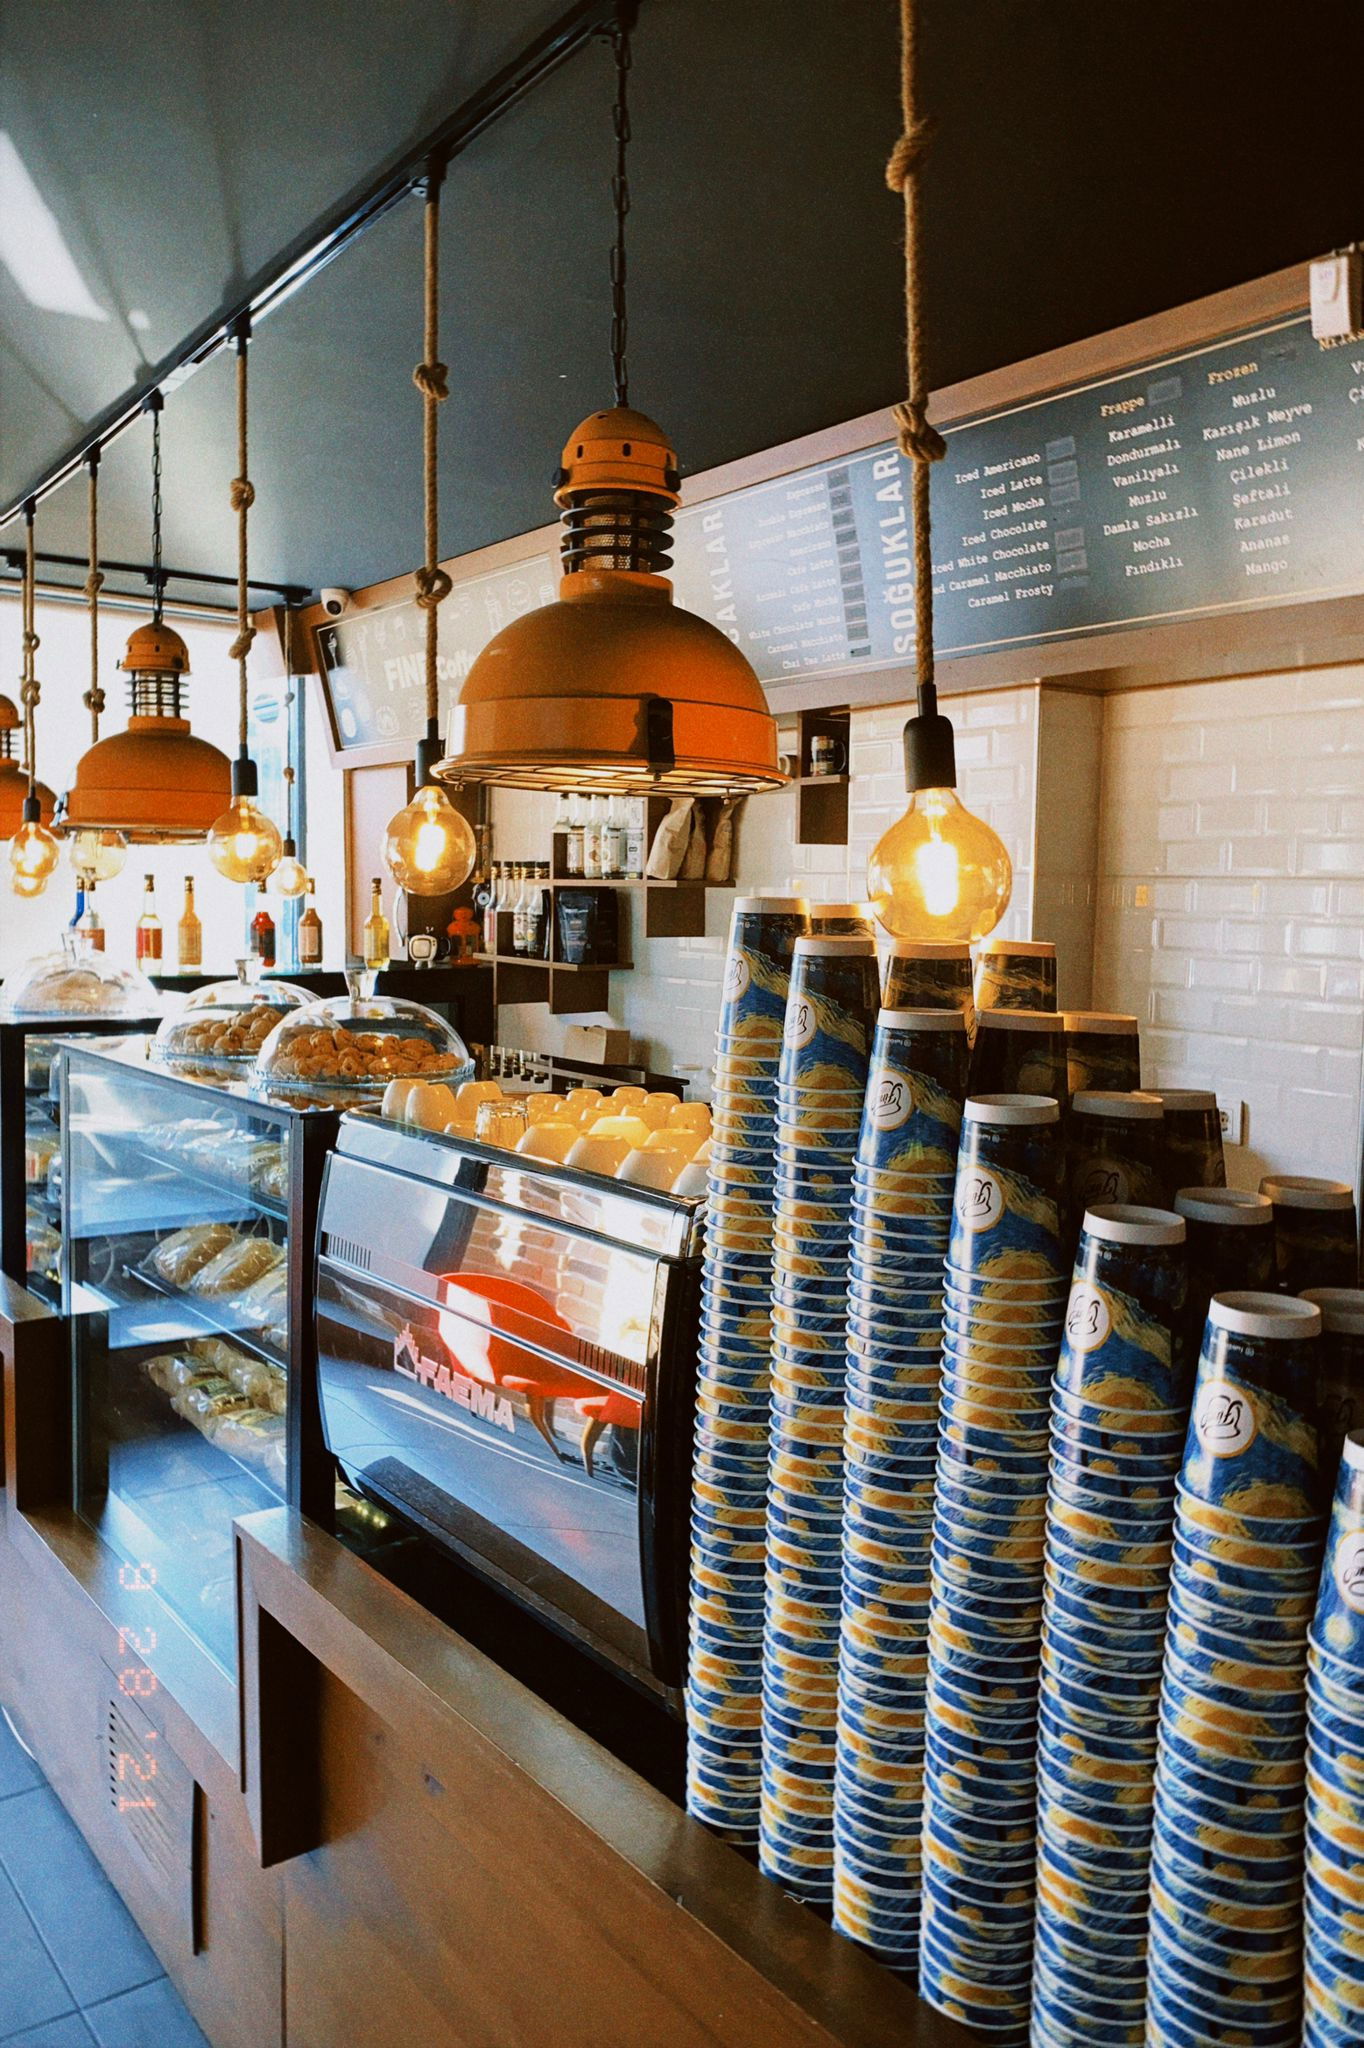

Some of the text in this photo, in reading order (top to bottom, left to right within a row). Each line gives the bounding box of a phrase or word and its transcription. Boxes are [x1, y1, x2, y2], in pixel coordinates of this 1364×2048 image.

[1208, 362, 1258, 385] Frozen
[1100, 397, 1144, 416] Frappe
[1232, 388, 1276, 408] Muzlu
[1267, 404, 1312, 424] Meyve
[1108, 414, 1176, 442] Karamelli
[1216, 432, 1300, 462] Nane Limon
[955, 454, 1040, 484] Iced Americano
[980, 476, 1042, 498] Iced Latte
[983, 498, 1046, 520] Iced Mocha
[1128, 490, 1168, 507] Muzlu
[1104, 520, 1140, 536] Damla
[1234, 508, 1295, 530] Karadut
[962, 520, 1048, 546] Iced Chocolate
[1133, 536, 1171, 552] Mocha
[1240, 534, 1290, 552] Ananas
[932, 542, 1050, 574] Iced White Chocolate
[1245, 560, 1288, 576] Mango
[949, 574, 990, 591] Caramel
[994, 563, 1052, 582] Macchiato
[968, 584, 1054, 608] Caramel Frosty
[416, 1356, 515, 1434] FAEMA
